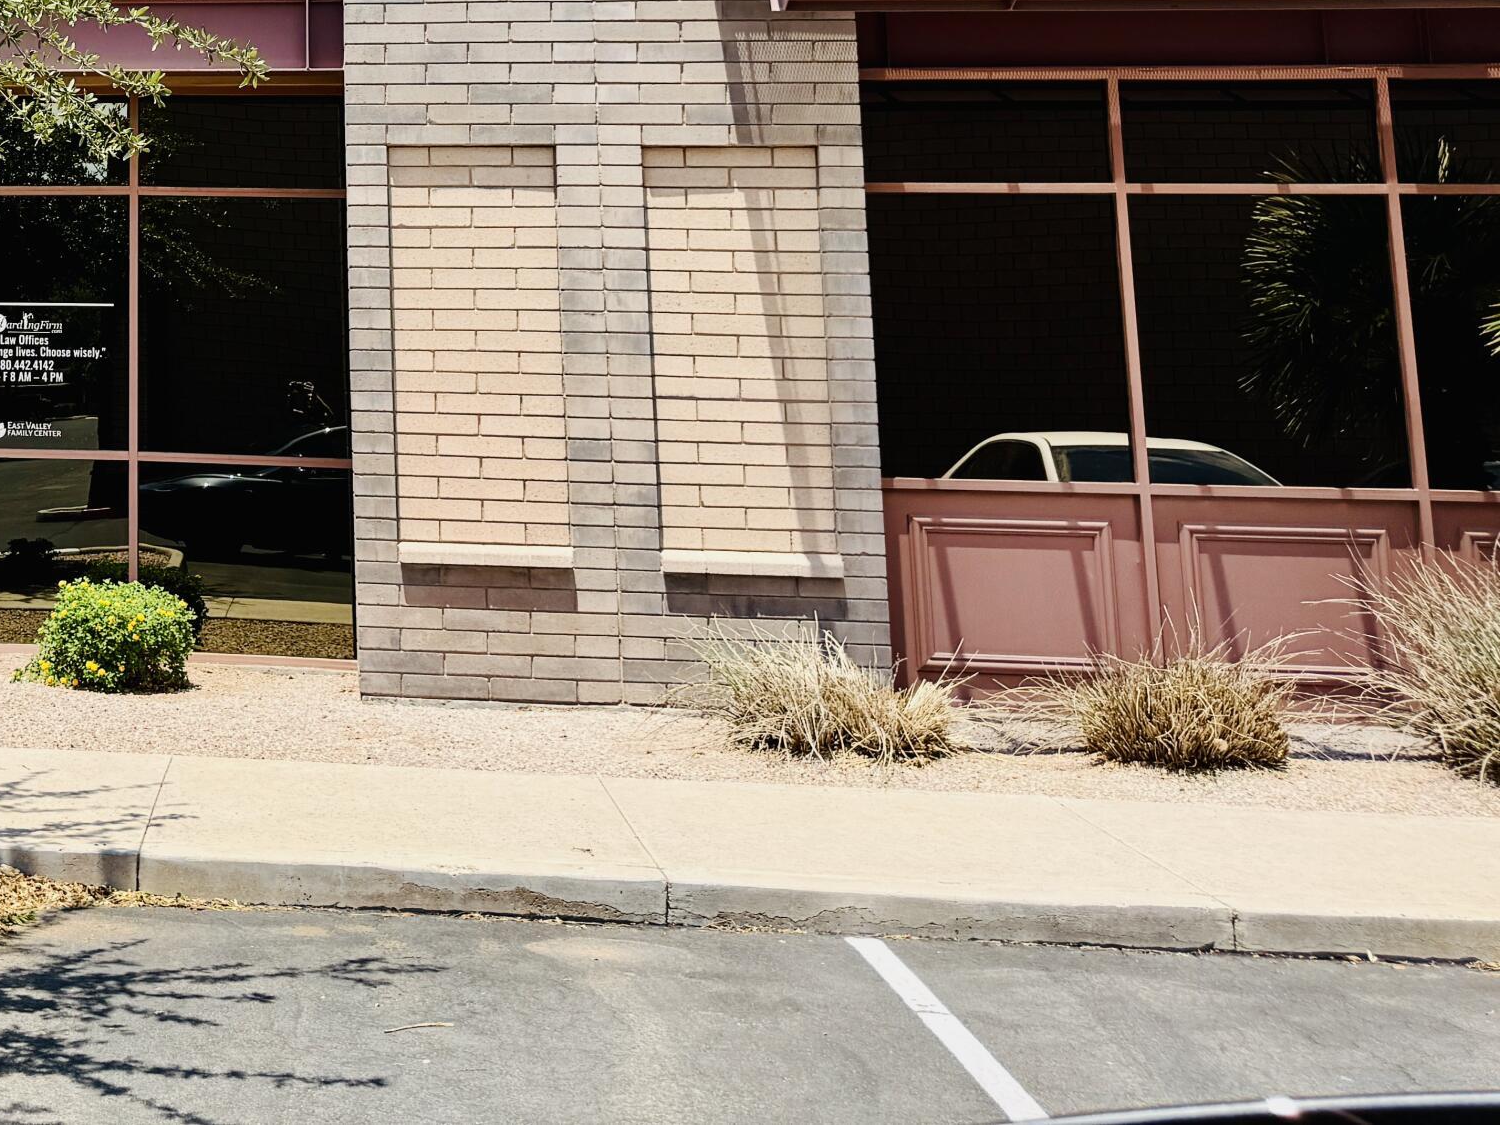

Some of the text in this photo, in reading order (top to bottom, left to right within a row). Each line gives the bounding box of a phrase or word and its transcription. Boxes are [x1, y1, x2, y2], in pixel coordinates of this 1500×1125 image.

[0, 334, 49, 345] Law Offices
[15, 347, 38, 357] lives.
[39, 347, 70, 357] Choose
[73, 347, 106, 359] wisely."
[3, 371, 8, 382] F
[10, 371, 16, 382] 8
[18, 372, 32, 382] AM
[41, 372, 48, 382] 4
[50, 372, 64, 382] PM
[7, 429, 33, 437] FAMILY
